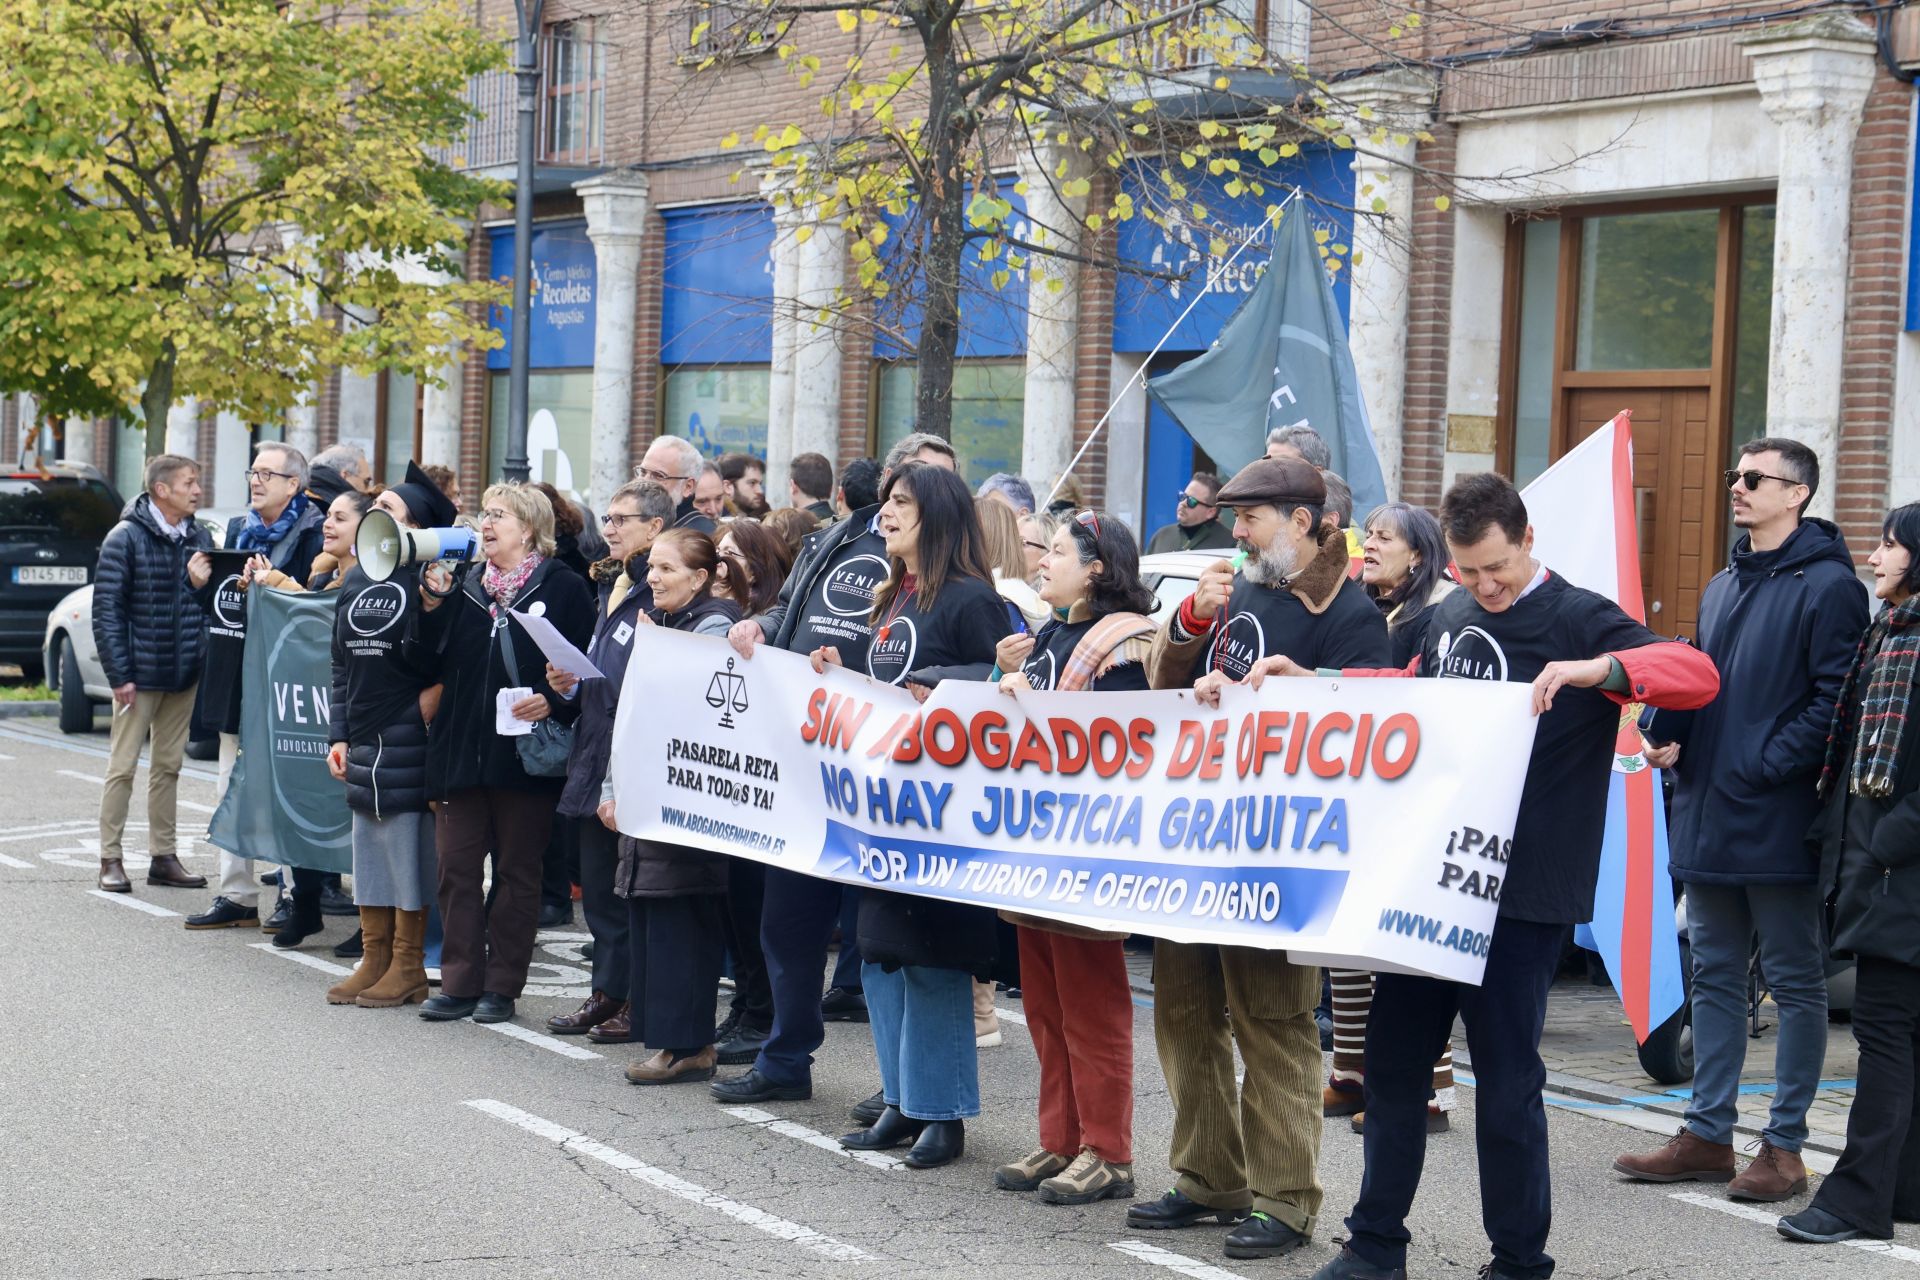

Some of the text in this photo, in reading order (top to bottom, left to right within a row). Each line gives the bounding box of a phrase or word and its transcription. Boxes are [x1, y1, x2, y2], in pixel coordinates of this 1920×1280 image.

[544, 267, 566, 281] Centro
[543, 280, 591, 305] Recoletas
[547, 309, 584, 330] Angustias
[358, 598, 397, 610] VENIA
[808, 616, 832, 626] SINDICATO
[840, 620, 872, 635] ABOGADOS
[815, 625, 858, 641] PROCURADORES
[874, 639, 907, 654] VENIA
[1447, 656, 1494, 680] VENIA
[274, 682, 331, 726] VEN
[277, 739, 332, 755] ADVOCATOR
[801, 688, 1421, 780] SIN ABOGADOS DE OFICIO
[667, 738, 779, 782] ¡PASARELA RETA
[667, 765, 775, 810] PARA TOD@S YA!
[821, 761, 1350, 853] NO HAY JUSTICIA GRATUITA
[662, 805, 786, 856] WWW.ABOGADOSENHUELGA.ES
[858, 843, 1281, 922] POR UN TURNO DE OFICIO DIGNO
[1438, 862, 1502, 903] PAR
[1378, 908, 1490, 958] WWW.ABOG
